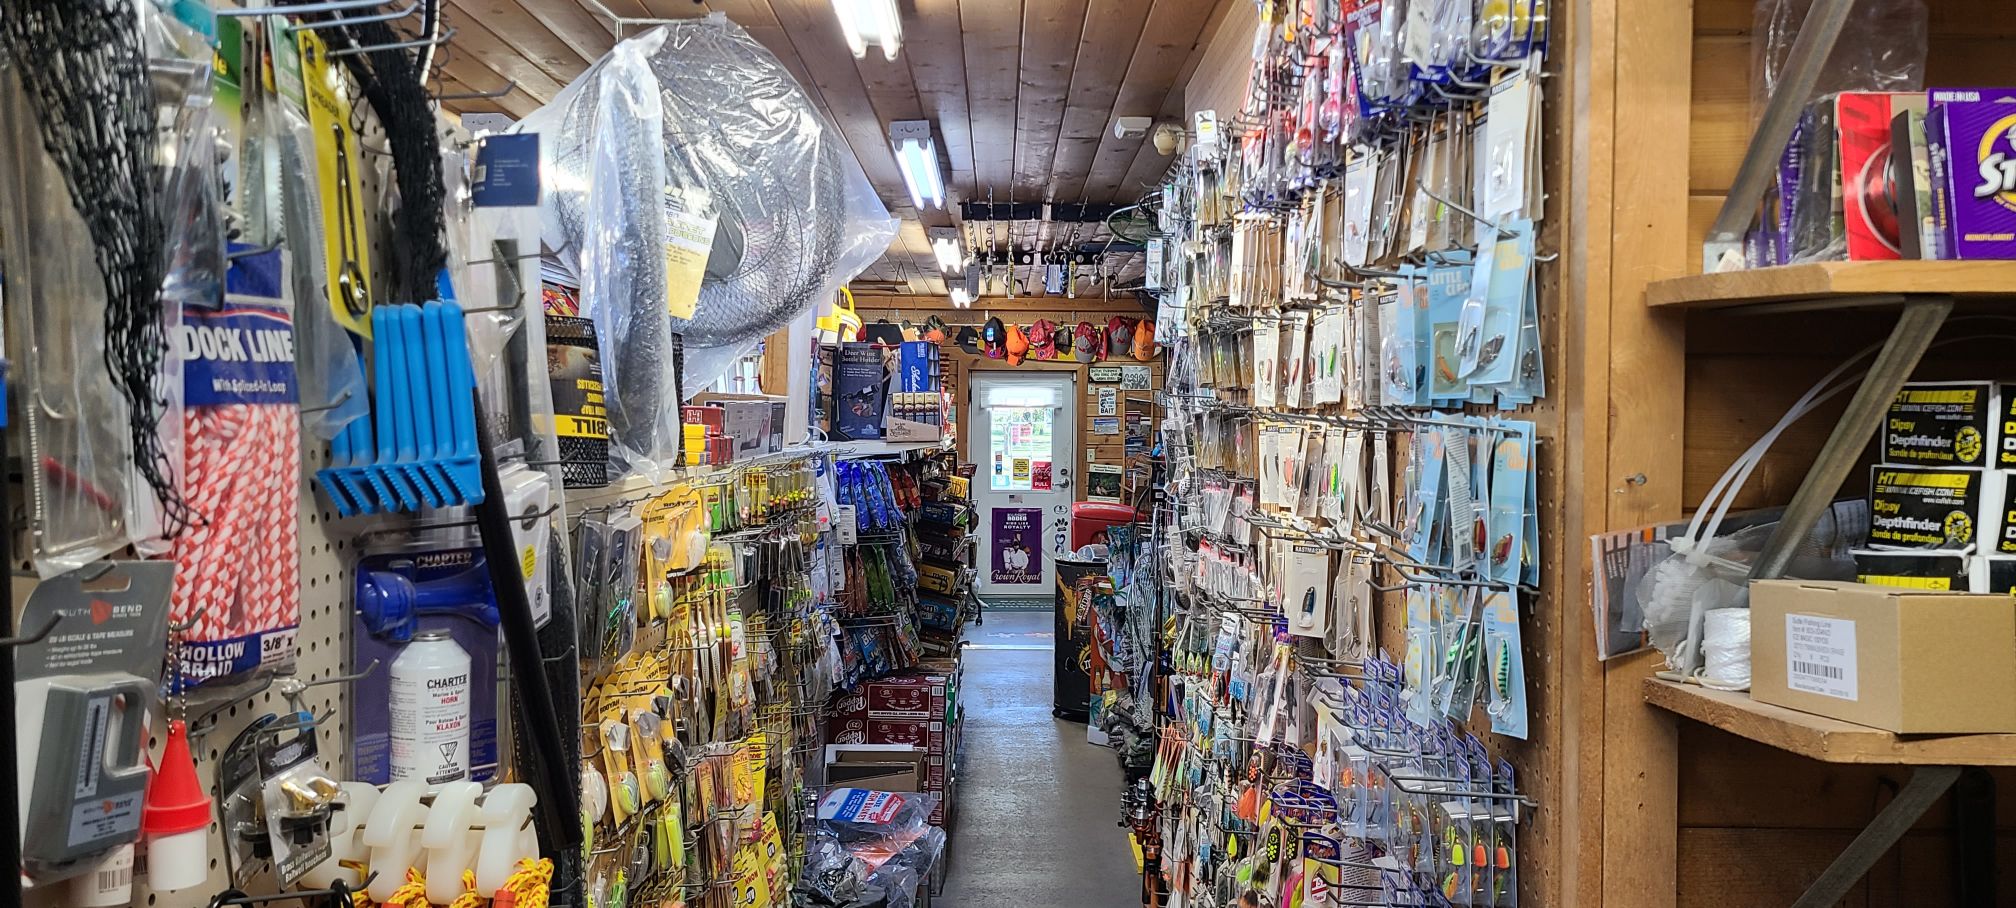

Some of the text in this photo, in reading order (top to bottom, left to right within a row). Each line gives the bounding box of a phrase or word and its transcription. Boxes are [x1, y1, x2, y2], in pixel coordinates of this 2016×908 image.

[1966, 91, 1981, 102] USA
[1430, 270, 1462, 286] LITTLE
[182, 325, 295, 363] DOCK LINE
[1889, 418, 1916, 432] Dipsy
[1889, 433, 1953, 448] Depthfinder
[1908, 449, 1918, 458] de
[1877, 471, 1898, 485] HT
[1874, 499, 1901, 514] Dipsy
[1873, 514, 1942, 532] Depthfinder
[1891, 530, 1902, 540] de
[990, 569, 1041, 584] Crown Royal
[112, 604, 143, 614] BEND
[107, 629, 134, 639] MEASURE
[180, 641, 246, 661] HOLLOW
[180, 660, 234, 677] BRAID
[441, 695, 459, 705] HORN
[599, 699, 620, 714] BOOYAH
[838, 695, 865, 711] Pepper
[845, 702, 857, 713] Dr
[436, 721, 461, 731] KLAXON
[837, 730, 863, 744] Pepper
[435, 766, 460, 776] ATTENTION
